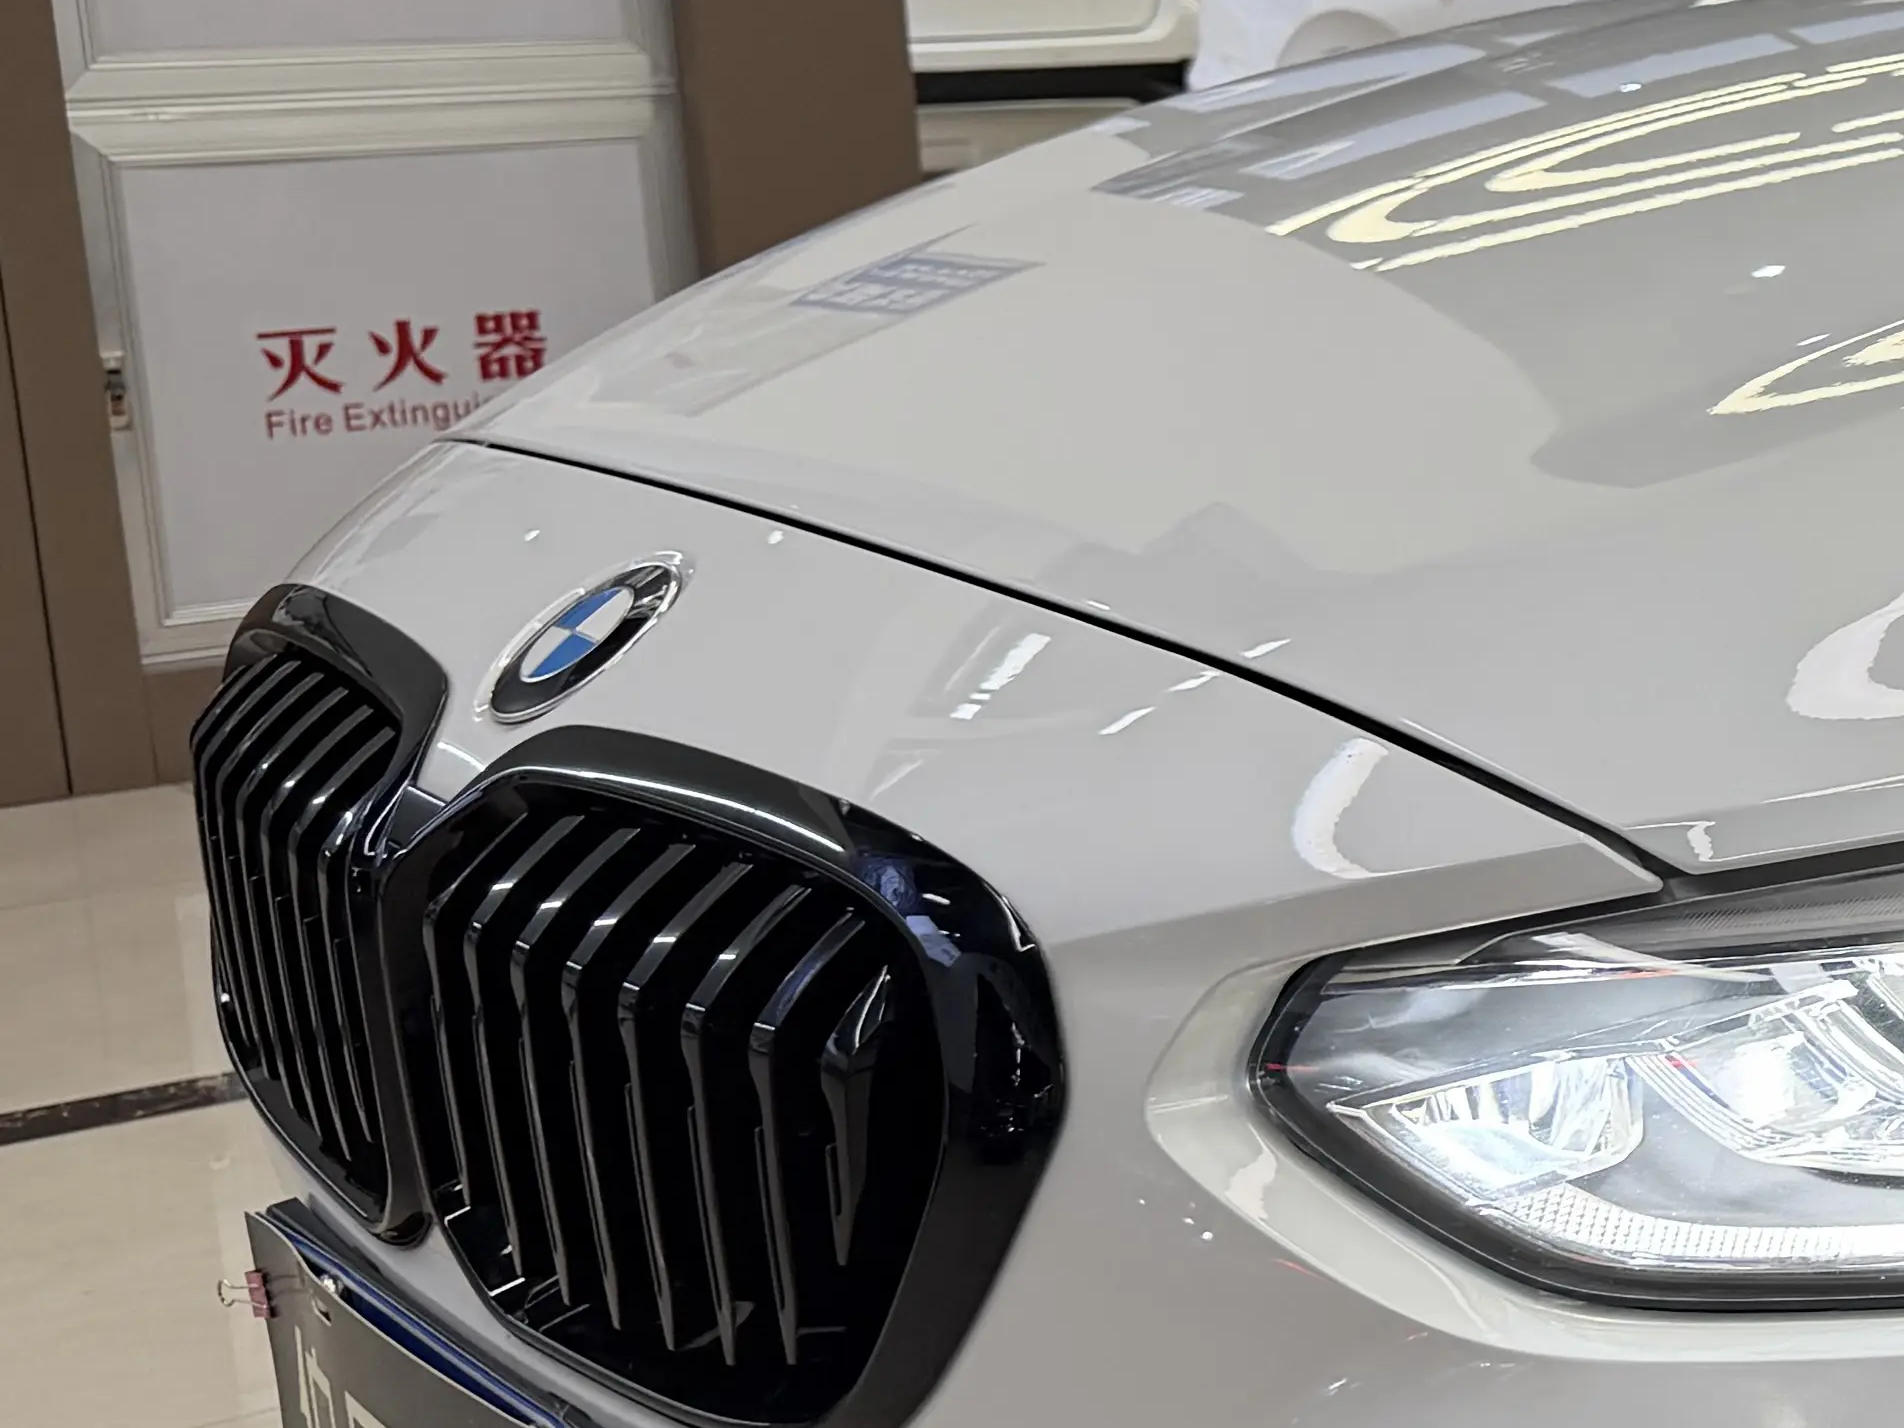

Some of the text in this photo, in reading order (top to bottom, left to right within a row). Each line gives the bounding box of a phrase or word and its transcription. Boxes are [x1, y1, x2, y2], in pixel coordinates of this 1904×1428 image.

[256, 309, 546, 402] 灭火器
[265, 391, 494, 439] Fire Extingui
